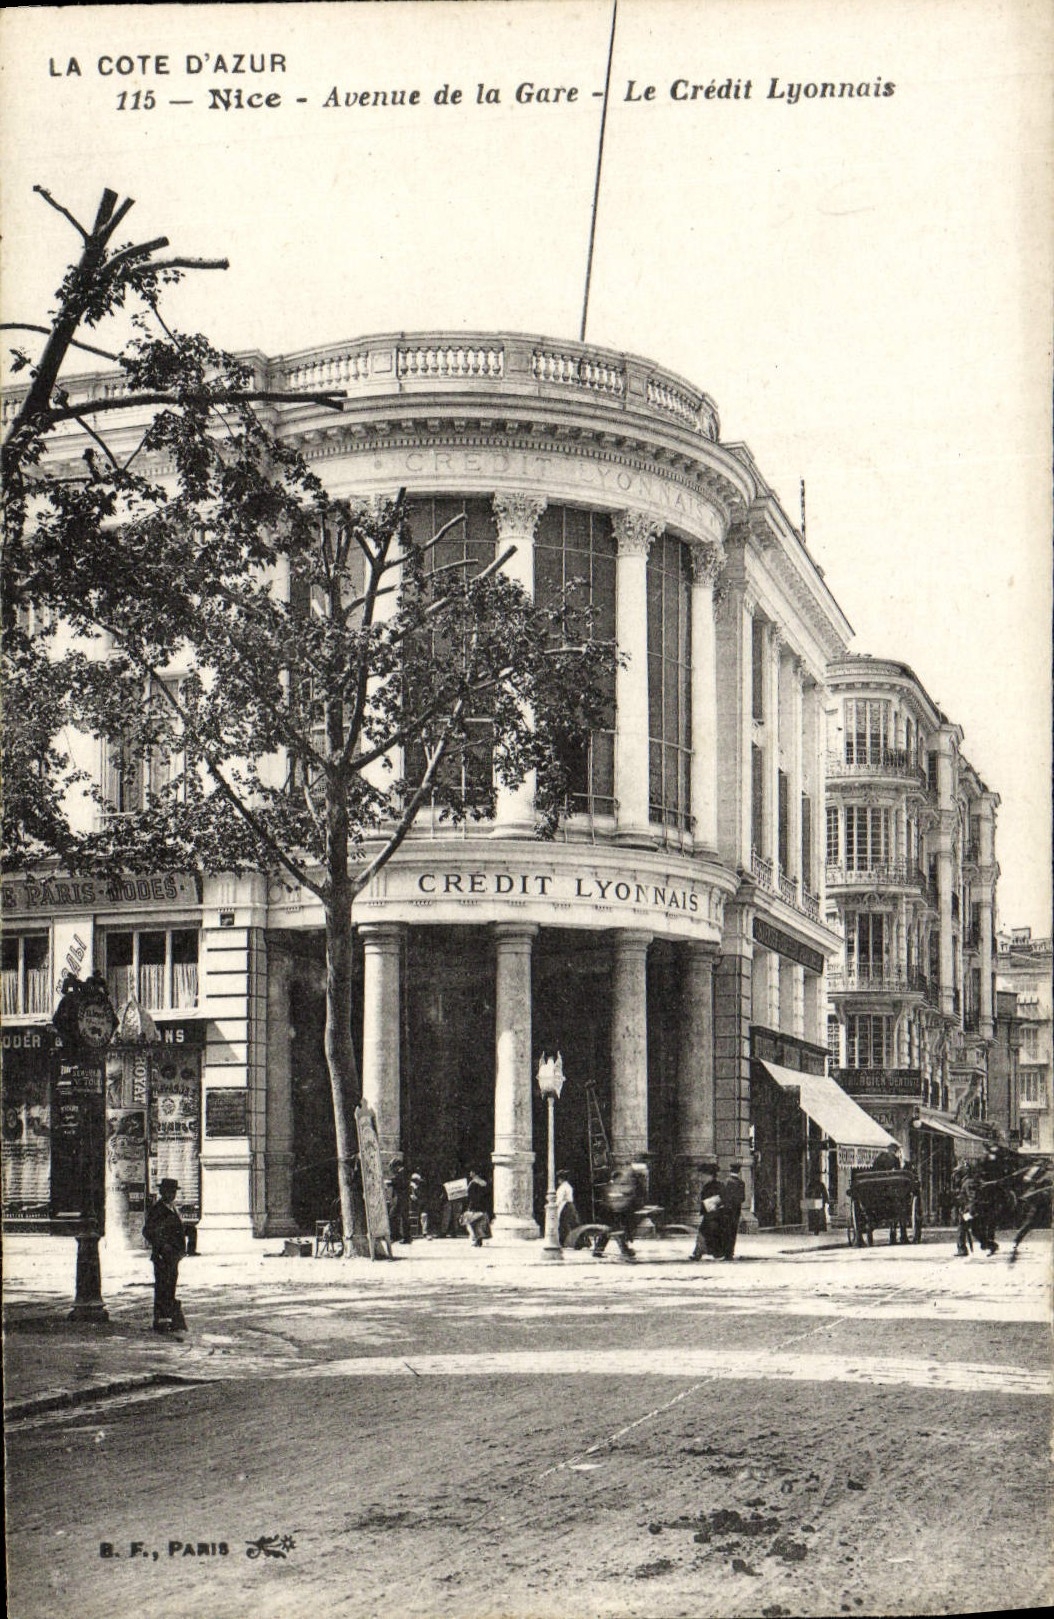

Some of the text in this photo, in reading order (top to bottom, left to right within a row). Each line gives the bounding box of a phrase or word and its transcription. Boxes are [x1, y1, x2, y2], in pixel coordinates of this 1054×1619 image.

[405, 452, 551, 477] CREDIT
[26, 881, 96, 908] PARIS
[576, 877, 699, 912] LYONNAIS
